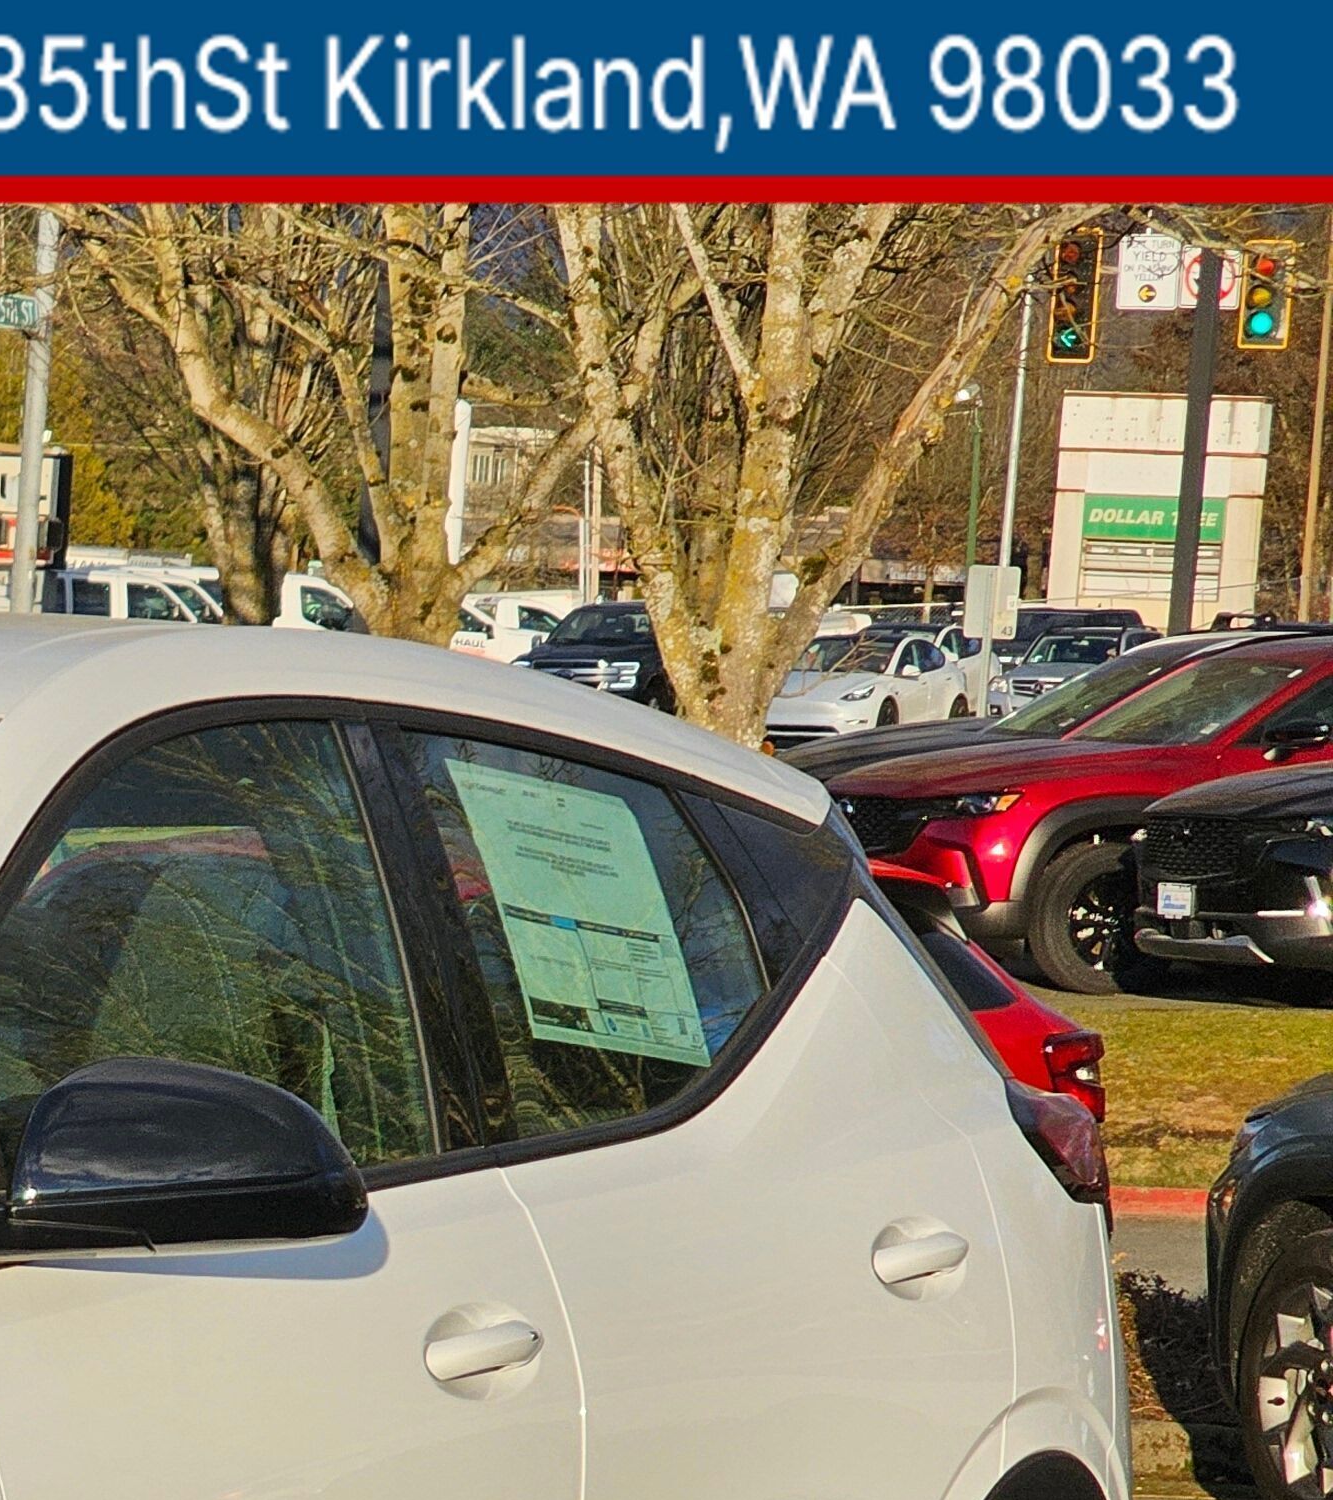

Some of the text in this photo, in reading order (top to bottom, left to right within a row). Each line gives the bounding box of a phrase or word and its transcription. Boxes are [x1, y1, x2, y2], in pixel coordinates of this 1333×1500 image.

[1134, 250, 1166, 261] YIELD
[1088, 508, 1219, 527] DOLLAR TEE
[1001, 626, 1013, 637] 43
